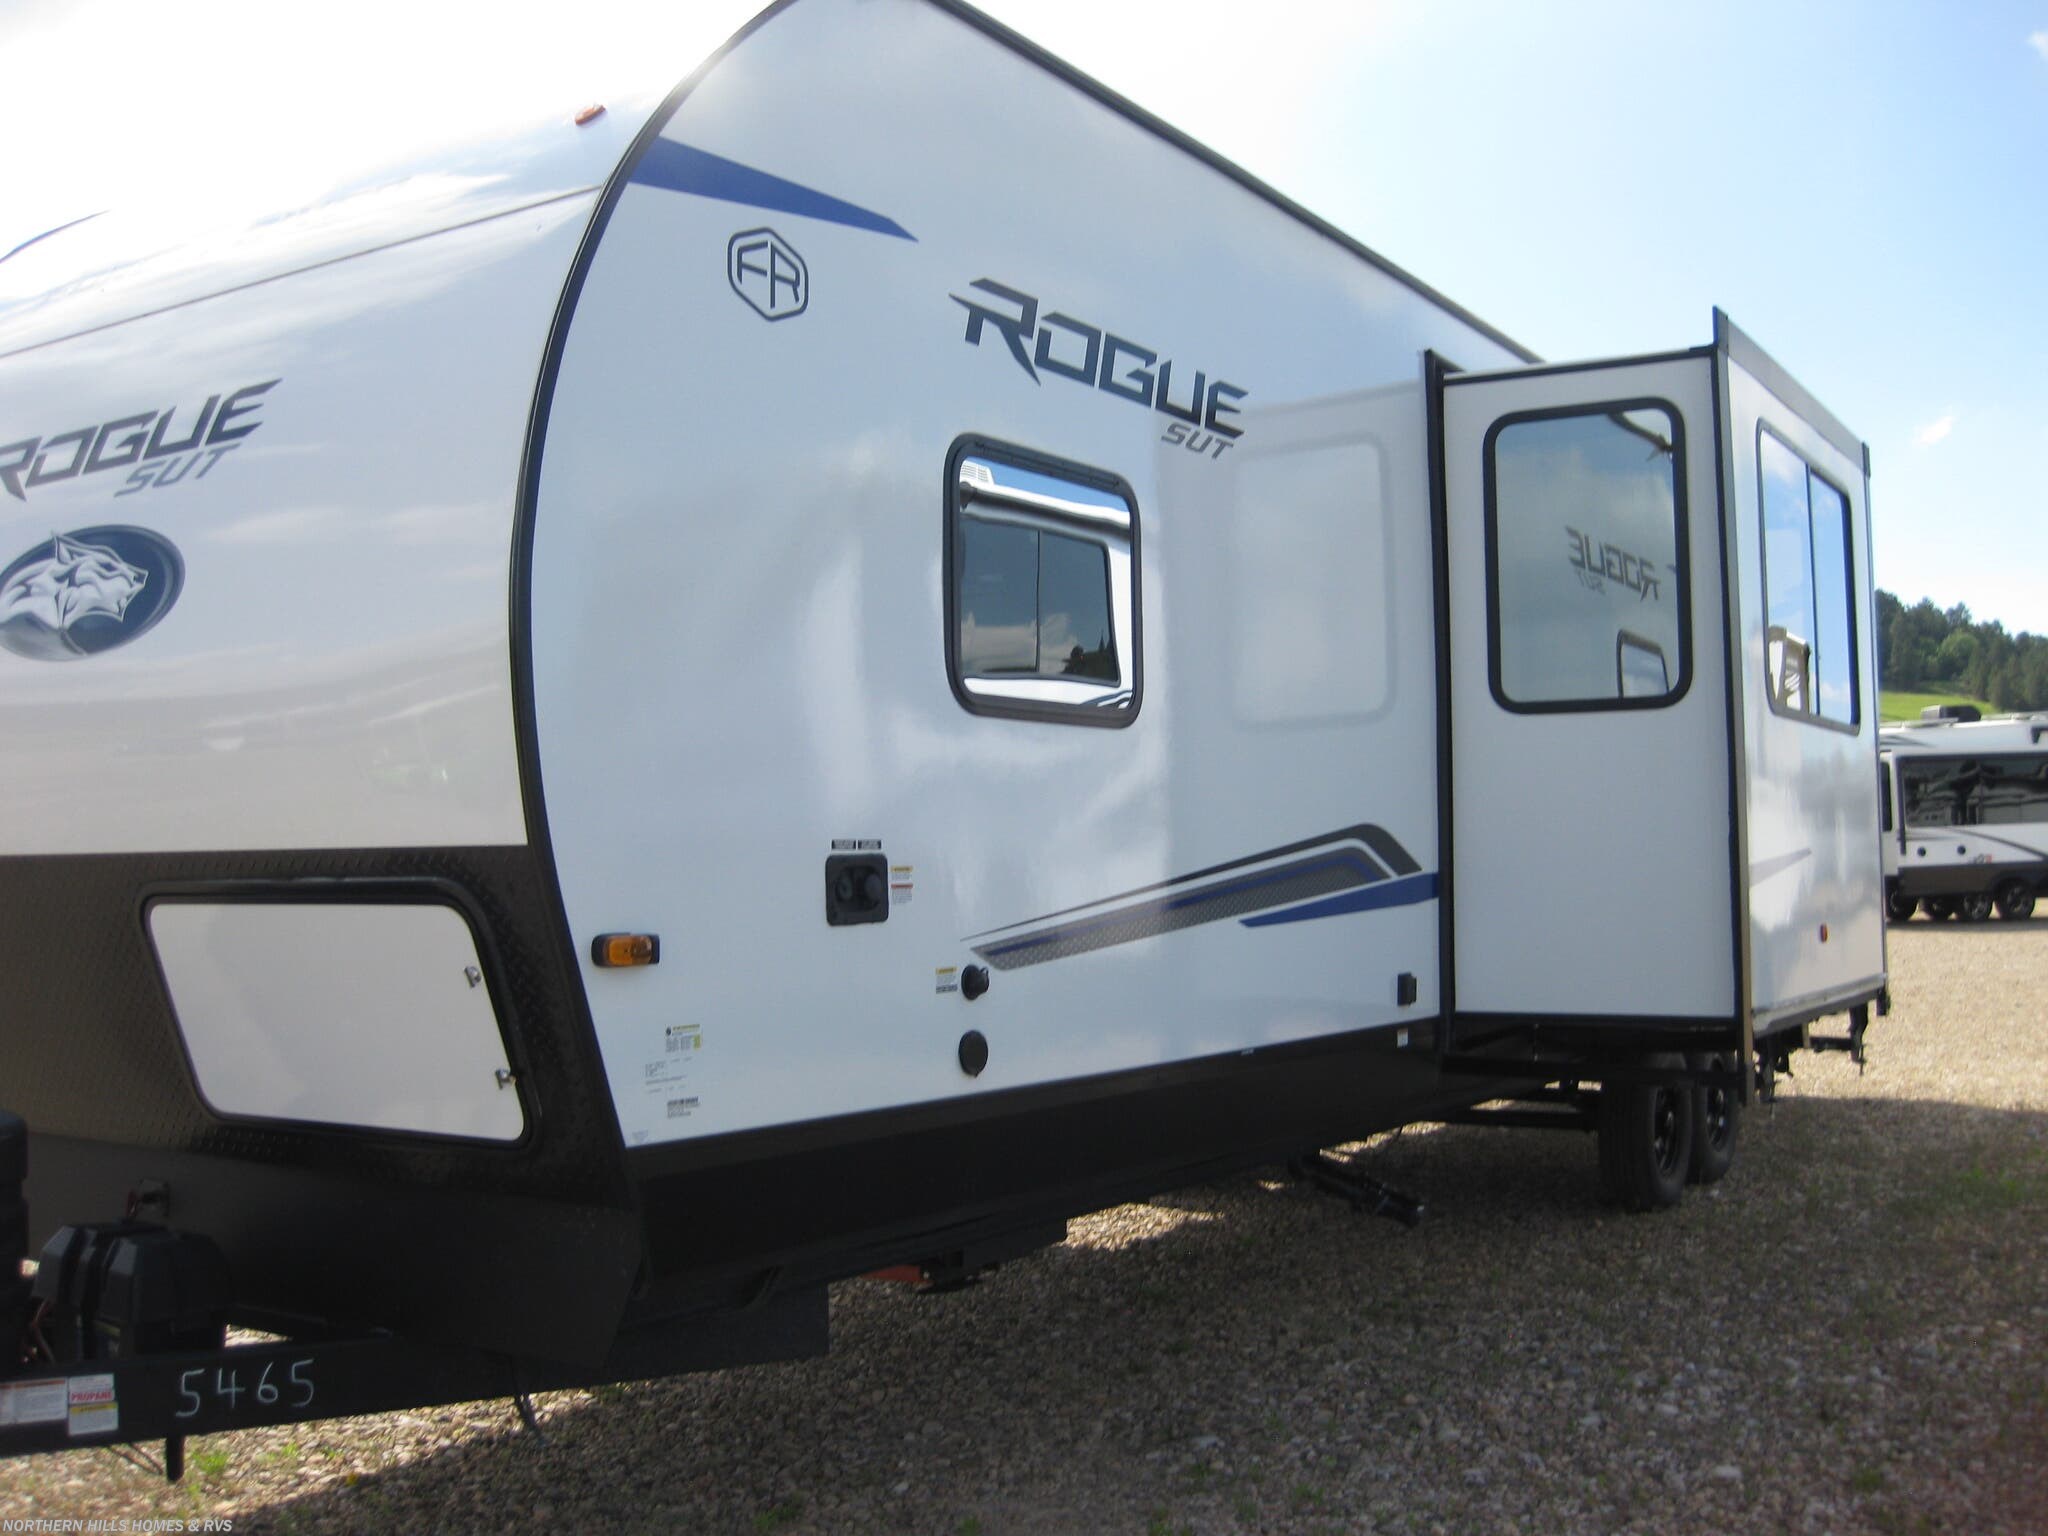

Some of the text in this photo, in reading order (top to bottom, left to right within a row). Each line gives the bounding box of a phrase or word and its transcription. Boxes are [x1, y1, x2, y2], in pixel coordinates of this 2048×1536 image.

[949, 277, 1249, 439] ROGUE
[0, 378, 283, 502] ROGUE
[1161, 422, 1234, 460] SUT
[113, 442, 242, 498] SUT
[175, 1359, 314, 1418] 5465
